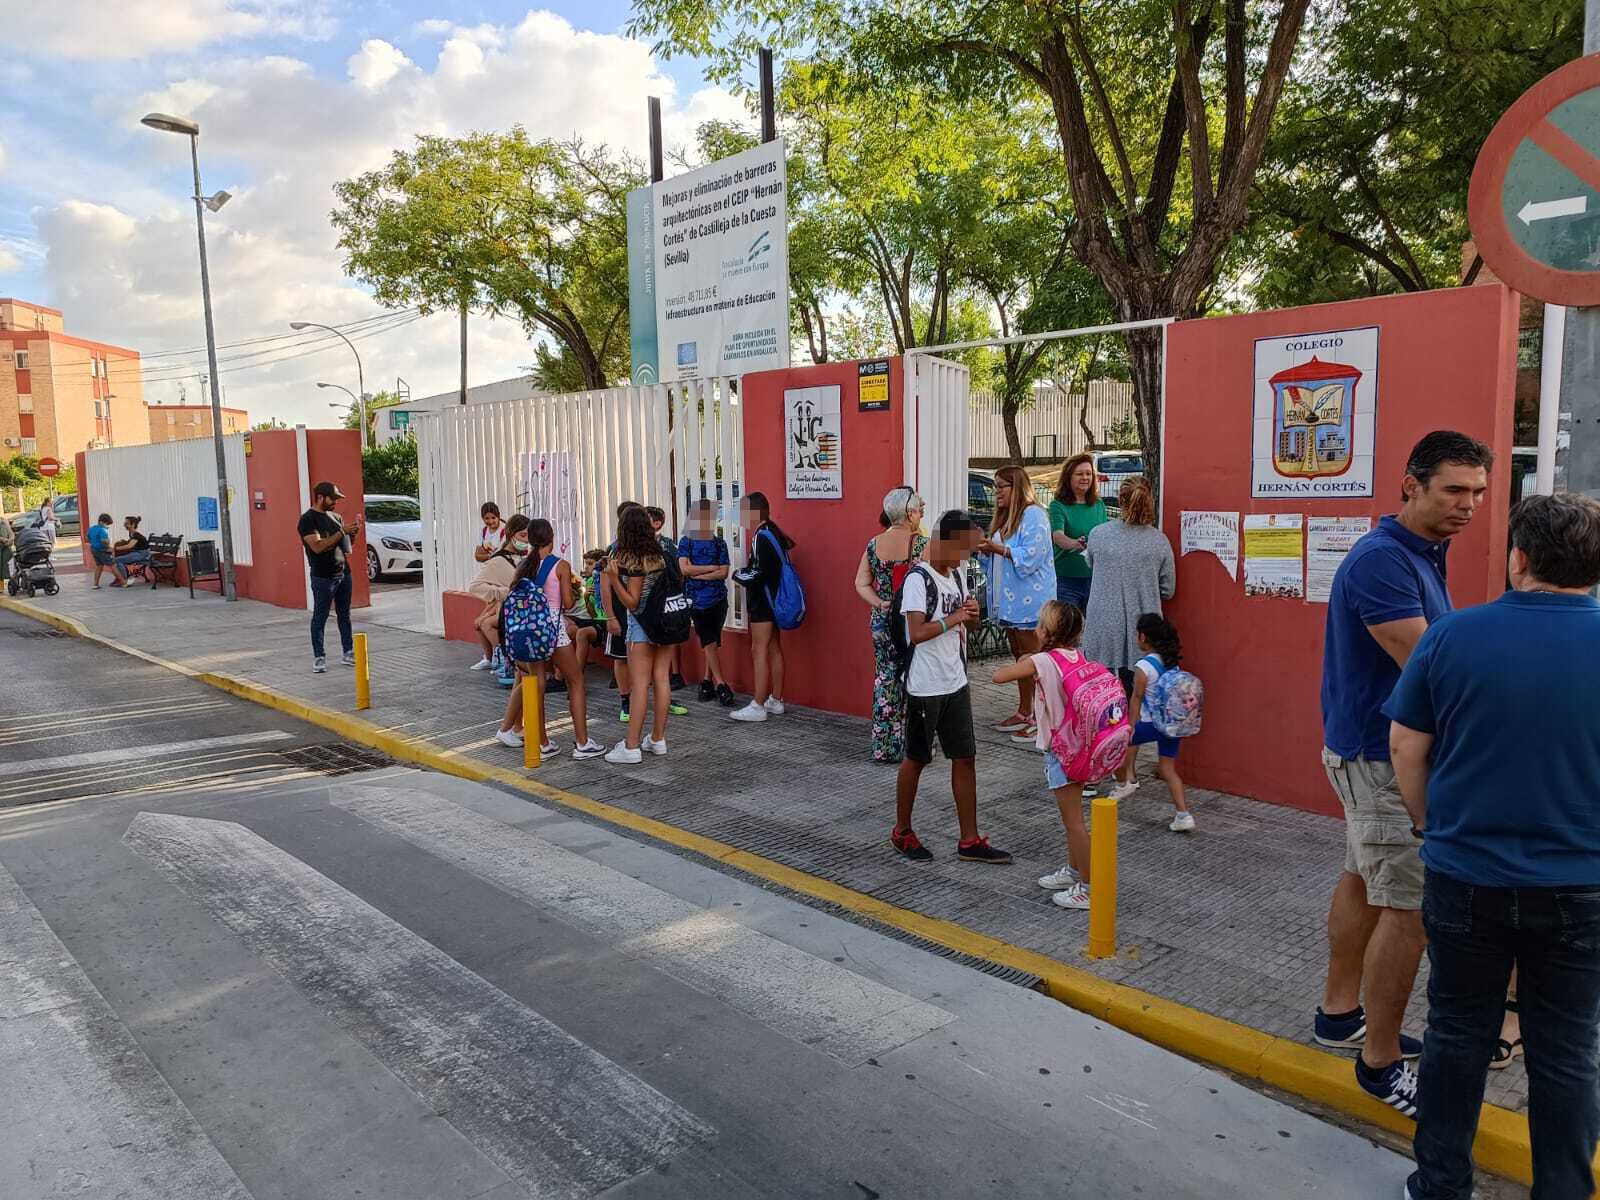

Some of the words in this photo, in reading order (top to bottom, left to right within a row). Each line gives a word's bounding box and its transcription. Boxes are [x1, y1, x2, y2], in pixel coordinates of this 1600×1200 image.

[662, 191, 688, 208] Mejoras
[688, 190, 693, 201] y
[694, 176, 732, 197] eliminación
[733, 170, 743, 182] de
[745, 161, 777, 181] barreras
[663, 202, 712, 228] arquitectónicas
[714, 200, 722, 213] en
[724, 197, 730, 208] el
[731, 189, 749, 207] CEIP
[689, 227, 698, 240] de
[698, 218, 730, 237] Castilleja
[731, 215, 740, 228] de
[742, 213, 749, 225] la
[750, 206, 776, 222] Cuesta
[664, 250, 690, 269] (Sevilla)
[713, 285, 717, 298] €
[665, 304, 705, 320] Infraestructura
[706, 304, 712, 314] en
[713, 300, 736, 312] materia
[737, 297, 744, 308] de
[745, 291, 776, 306] Educación
[1286, 338, 1343, 352] COLEGIO
[1258, 479, 1312, 493] HERNÁN
[1314, 478, 1366, 492] CORTÉS
[664, 598, 687, 613] ANS
